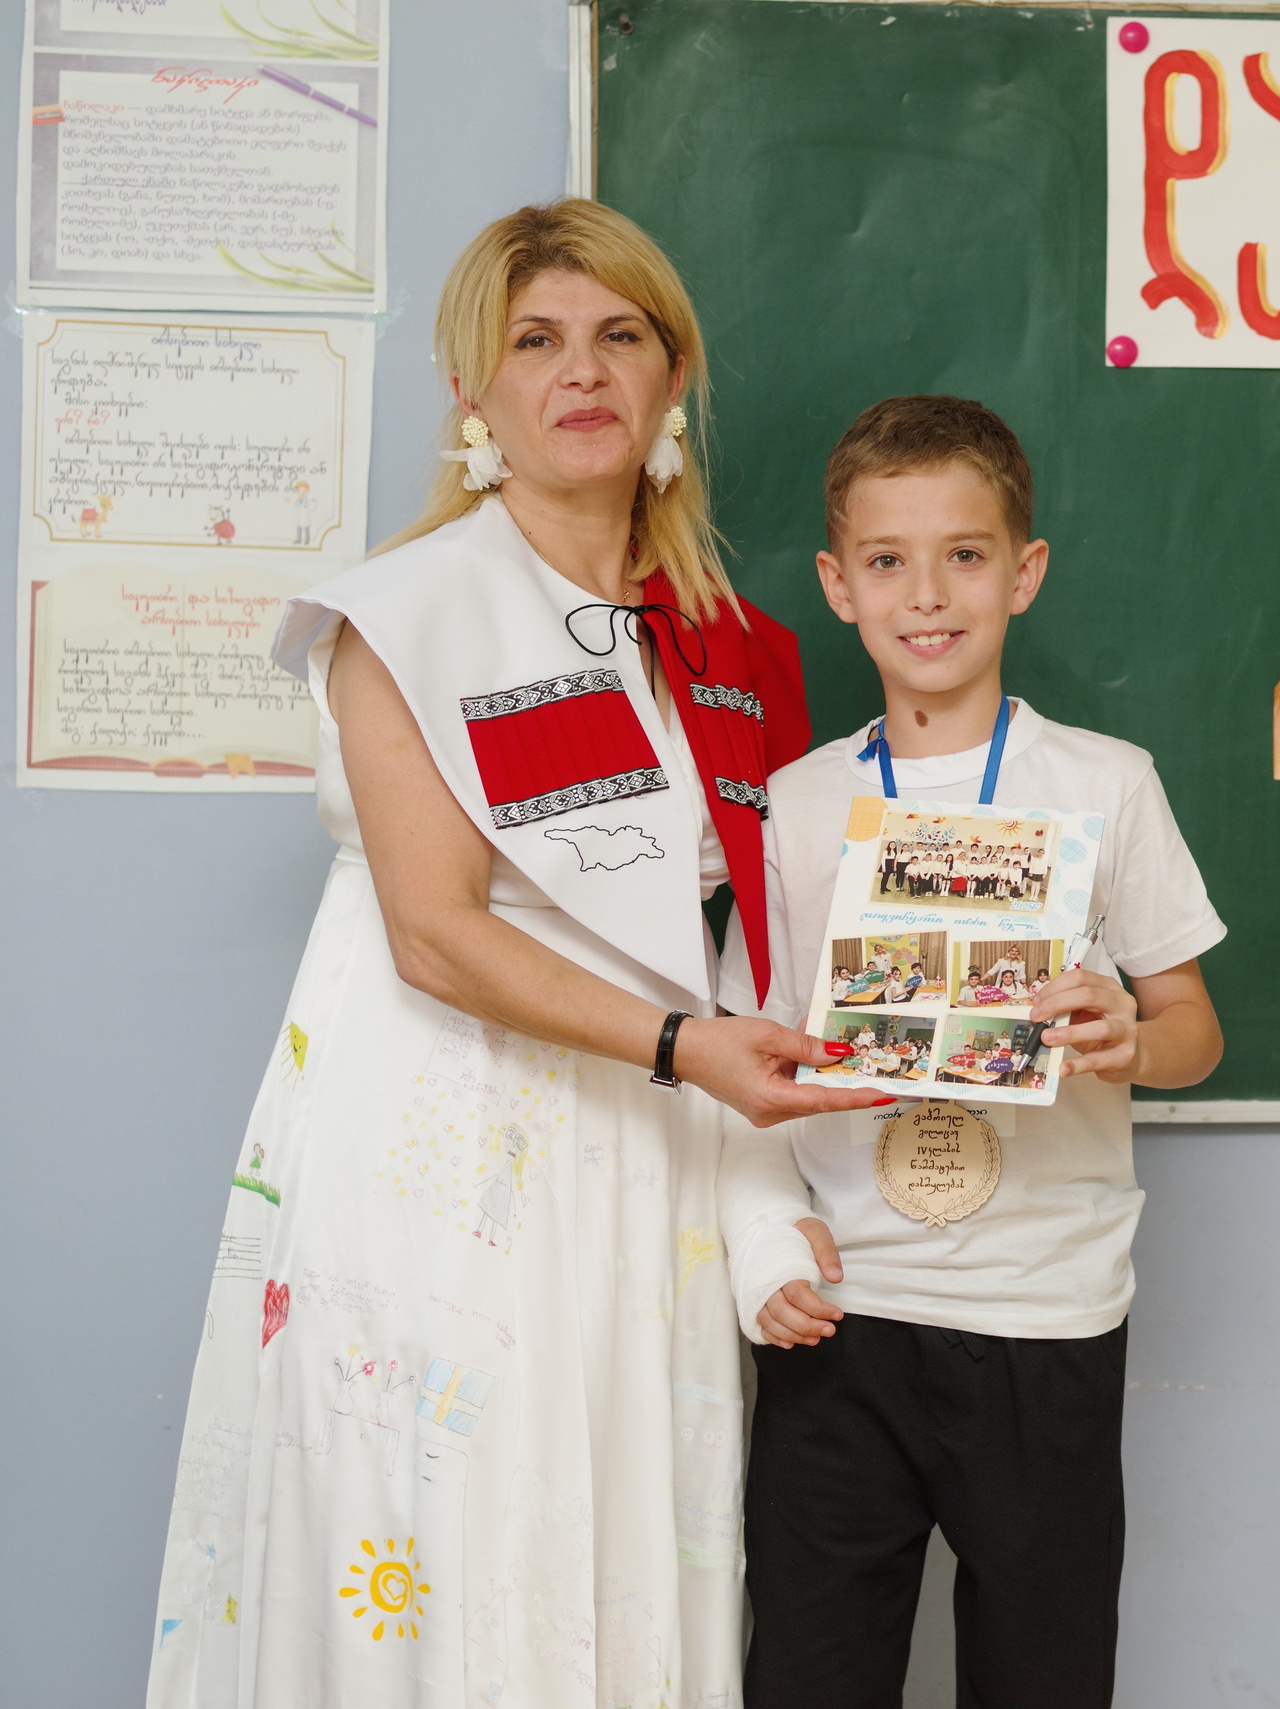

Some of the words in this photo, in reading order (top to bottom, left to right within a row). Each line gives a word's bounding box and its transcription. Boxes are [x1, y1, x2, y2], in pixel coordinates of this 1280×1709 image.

[150, 66, 260, 105] ნაწილაკი
[63, 100, 125, 114] ნაწილაკი
[145, 104, 207, 118] დამხმარე
[210, 106, 254, 120] სიტყვა
[258, 109, 271, 118] ან
[274, 109, 333, 122] მორფემა,
[64, 116, 130, 129] რომელსაც
[133, 117, 187, 131] სიტყვის
[190, 120, 208, 131] (ან
[211, 121, 301, 136] წინადადების)
[63, 129, 163, 144] მნიშვნელობაში
[166, 134, 248, 148] დამატებითი
[250, 139, 304, 151] ელფერი
[307, 139, 347, 153] შეაქვს
[62, 145, 80, 156] და
[83, 145, 148, 159] აღნიშნავს
[151, 147, 236, 163] მოლაპარაკის
[62, 159, 186, 174] დამოკიდებულებას
[190, 163, 274, 177] სათქმელთან.
[81, 174, 138, 187] ქართულ
[142, 176, 176, 187] ენაში
[179, 177, 254, 192] ნაწილაკები
[257, 182, 340, 196] გადმოსცემენ
[61, 189, 114, 200] კითხვას
[239, 194, 313, 209] მიმართებას
[140, 205, 268, 221] განუსაზღვრელობას
[145, 220, 210, 234] უკუთქმას
[61, 230, 112, 244] სიტყვას
[238, 239, 336, 252] დადასტურებას
[111, 248, 149, 260] დიახ)
[152, 251, 170, 261] და
[174, 249, 204, 263] სხვა.
[151, 326, 209, 358] არსებითი
[215, 327, 261, 362] სახელი
[51, 348, 88, 375] საგნის
[210, 355, 257, 382] არსებითი
[261, 357, 299, 385] სახელი
[65, 389, 89, 405] მისი
[55, 408, 83, 434] ვინ?
[87, 409, 110, 426] რა?
[65, 428, 112, 455] არსებითი
[116, 430, 155, 457] სახელი
[246, 435, 293, 462] სულიერი
[297, 438, 312, 453] ან
[98, 449, 149, 476] საკუთარი
[153, 452, 166, 468] ან
[310, 461, 327, 474] ან
[48, 488, 92, 514] კრებითი.
[121, 582, 177, 612] საკუთარი
[188, 594, 210, 610] და
[215, 585, 281, 617] საზოგადო
[141, 607, 201, 636] არსებითი
[206, 609, 261, 639] სახელები
[124, 640, 171, 667] არსებითი
[114, 660, 151, 687] საგანს
[136, 681, 190, 706] არსებითი
[913, 1107, 964, 1128] გაბრიელ
[918, 1129, 959, 1141] გილოცავ
[910, 1160, 965, 1176] წარმატებით
[908, 1177, 965, 1195] დასრულებას
